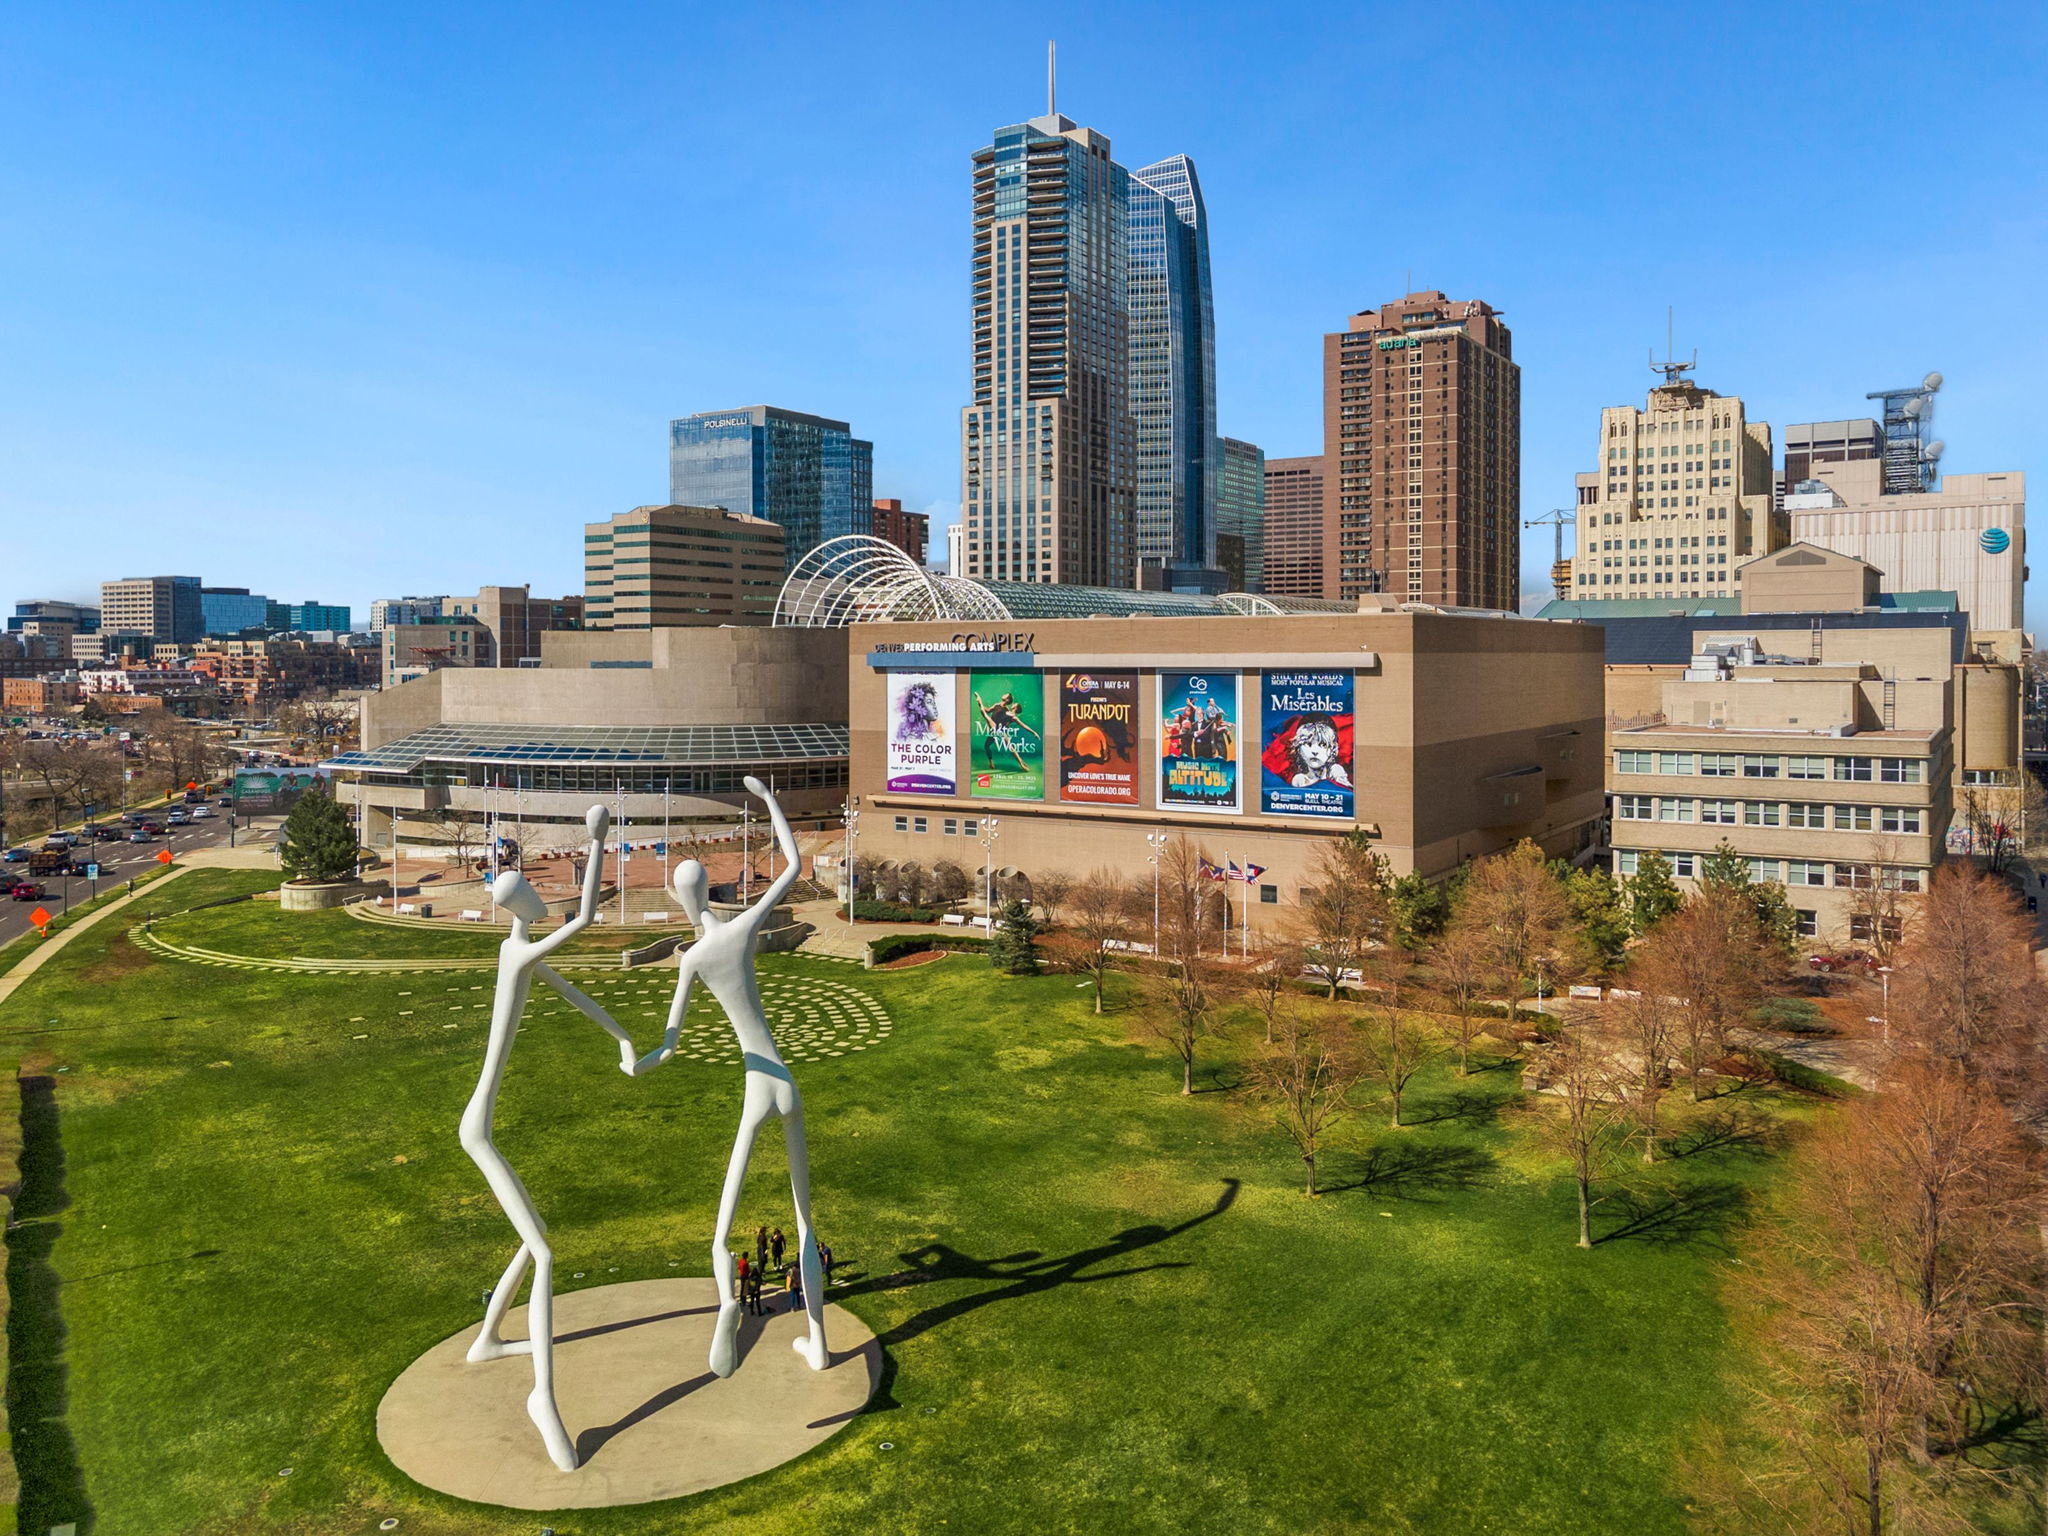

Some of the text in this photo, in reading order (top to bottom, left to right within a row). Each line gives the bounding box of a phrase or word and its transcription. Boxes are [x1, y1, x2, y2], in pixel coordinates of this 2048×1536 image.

[904, 642, 967, 652] PERFORMING
[969, 642, 995, 652] ARTS
[1105, 681, 1130, 689] MAY 6-14
[1297, 687, 1315, 700] Les
[1271, 694, 1344, 712] Misérables
[1068, 704, 1131, 724] TURANDOT
[891, 743, 952, 755] THE COLOR
[993, 737, 1036, 753] Works
[901, 754, 942, 765] PURPLE
[1175, 761, 1199, 770] MUSIC
[1068, 771, 1089, 780] UNCOVER
[1169, 769, 1227, 787] ALTITUDE
[1068, 784, 1131, 797] OPERACOLORADO.ORG
[1305, 792, 1320, 800] MAY
[1270, 802, 1344, 813] DENVERCENTER.ORG
